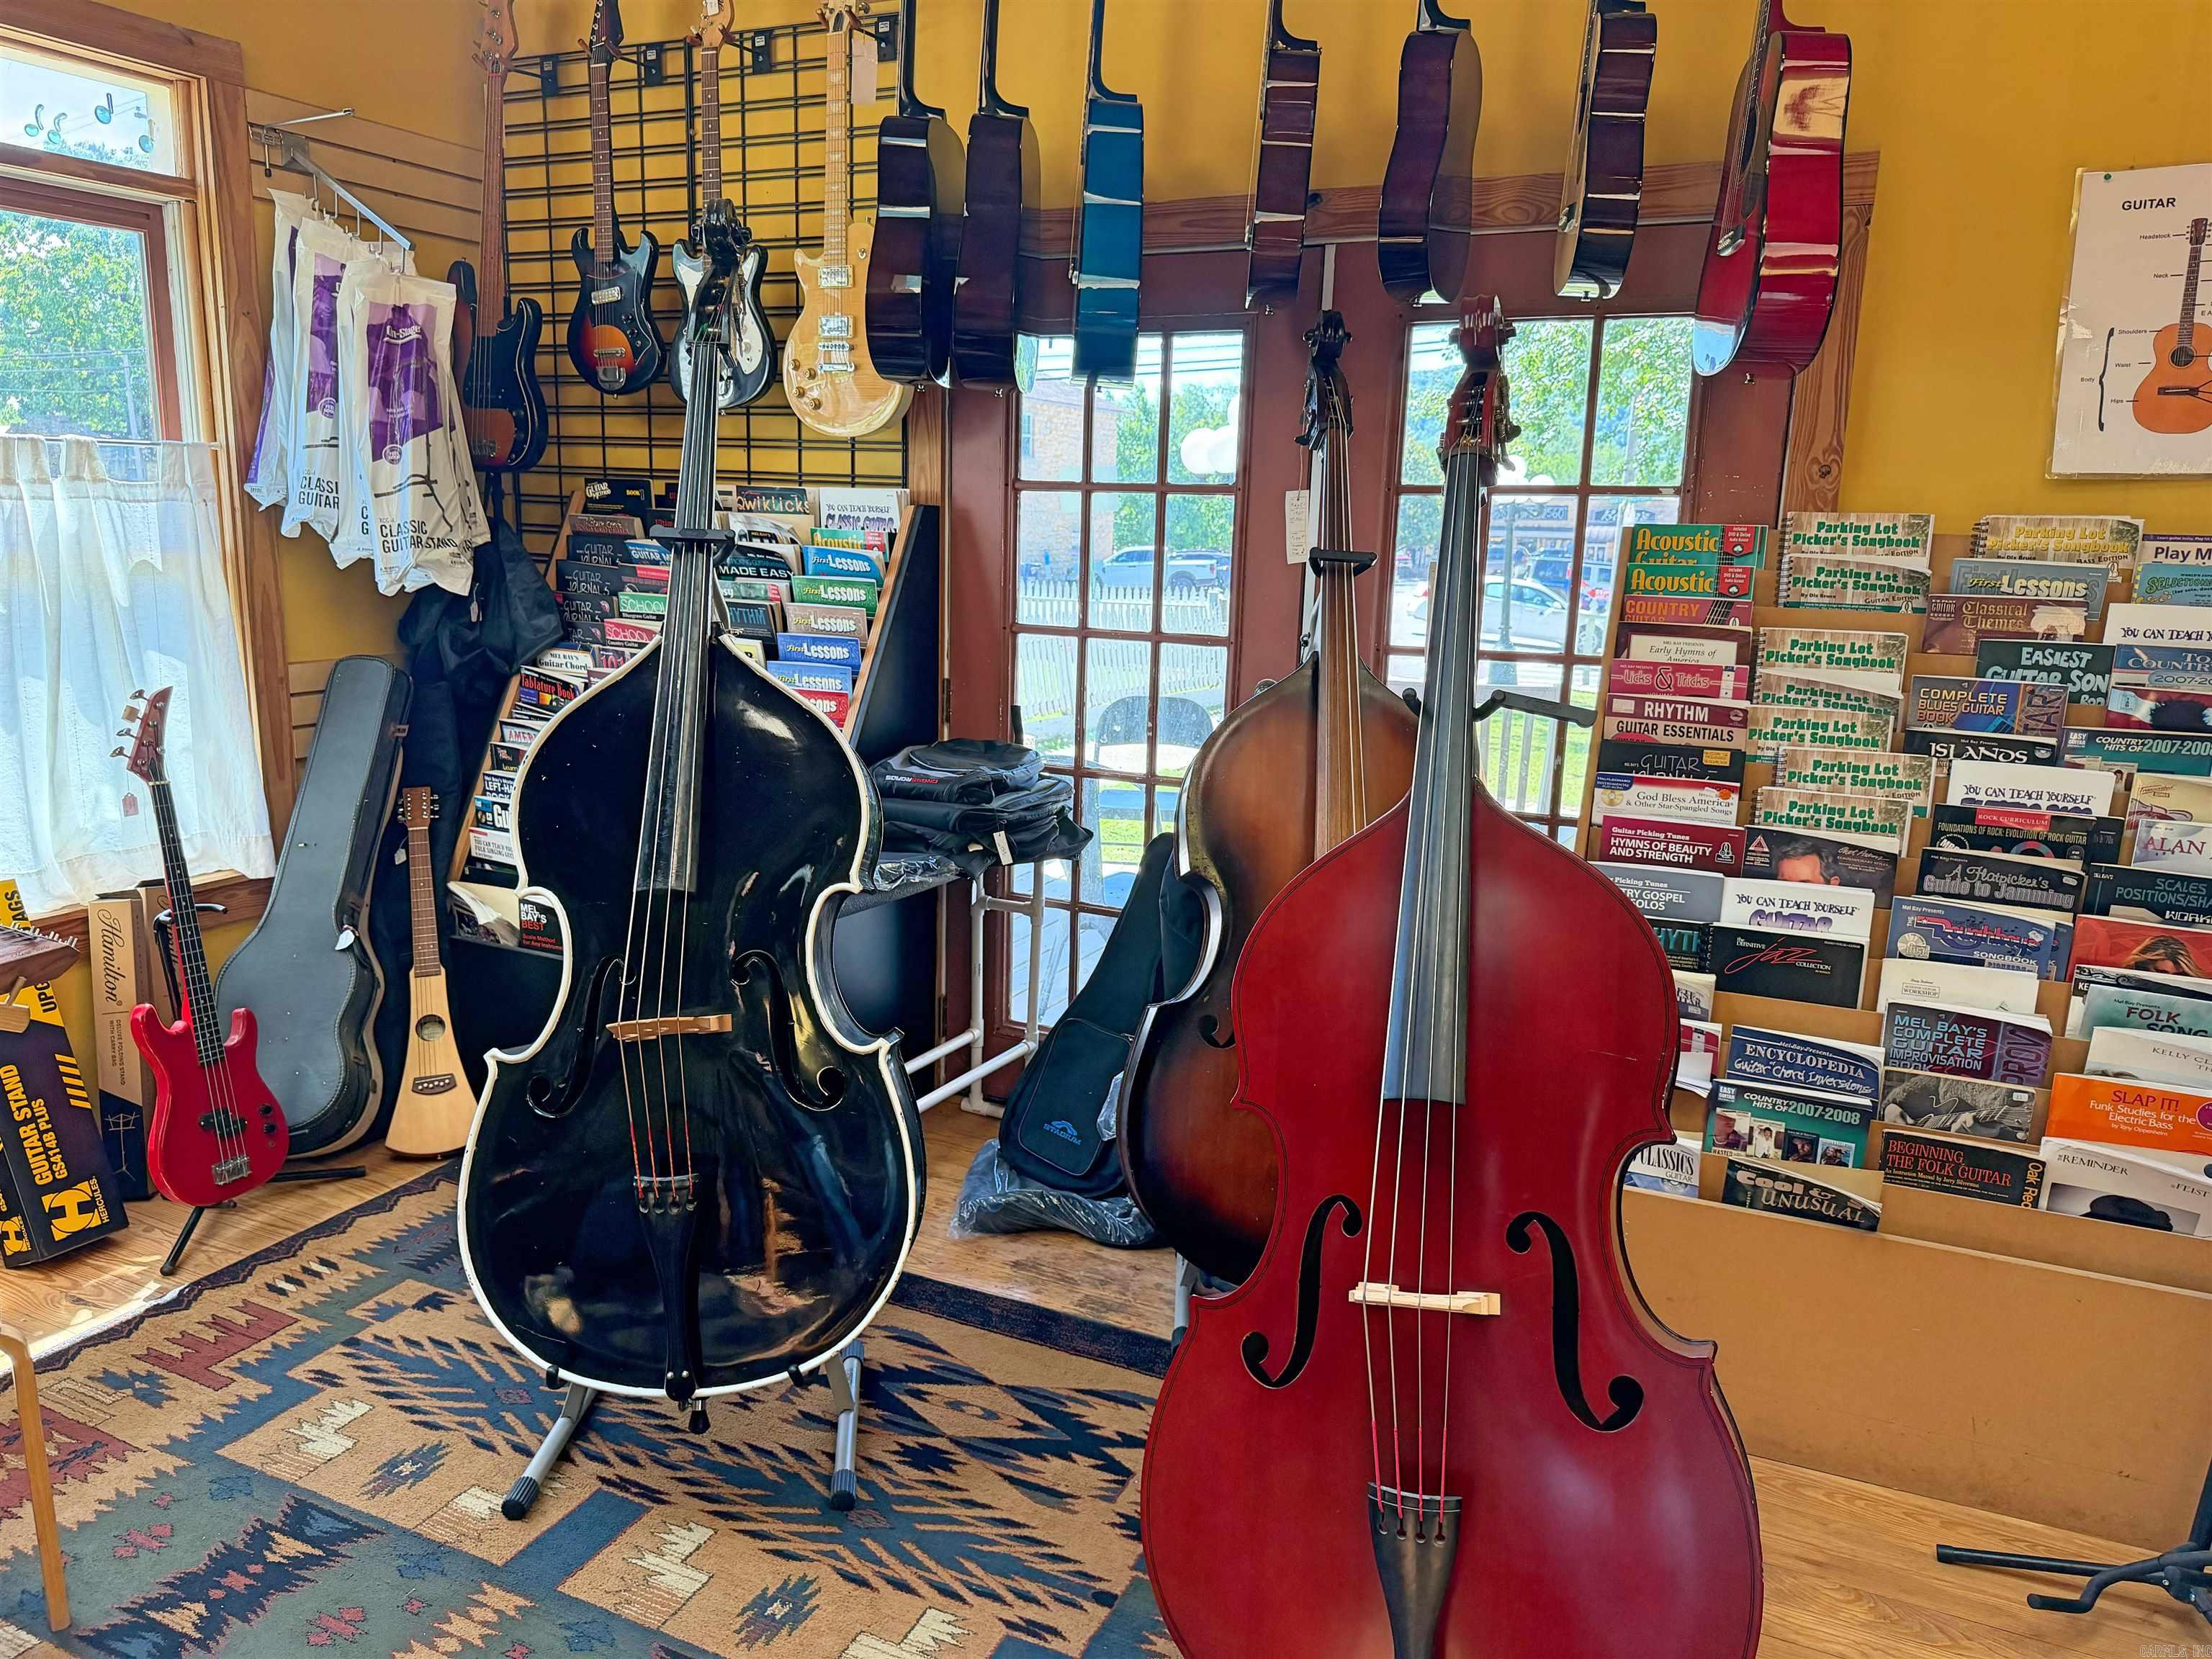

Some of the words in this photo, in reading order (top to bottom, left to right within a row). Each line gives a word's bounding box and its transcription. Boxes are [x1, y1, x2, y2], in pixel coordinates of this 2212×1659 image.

[2122, 198, 2176, 210] GUITAR
[387, 325, 421, 338] On-Stage
[849, 504, 866, 513] TEACH
[380, 520, 428, 538] CLASSIC
[1817, 521, 1871, 535] Parking
[1875, 523, 1898, 534] Lot
[2015, 526, 2076, 540] Parking
[2080, 527, 2106, 539] Lot
[382, 536, 423, 553] GUITAR
[424, 537, 457, 549] STAND
[585, 544, 613, 554] GUITAR
[1636, 528, 1719, 552] Acoustic
[1792, 534, 1848, 546] Picker's
[1852, 534, 1920, 549] Songbook
[631, 551, 660, 561] GUITAR
[812, 556, 830, 565] First
[830, 554, 871, 572] Lessons
[2154, 547, 2190, 562] Play
[719, 565, 757, 576] MADE
[761, 567, 794, 577] EASY
[1816, 567, 1871, 581] Parking
[1875, 571, 1898, 583] Lot
[1631, 568, 1714, 593] Acoustic
[1791, 577, 1848, 590] Picker's
[1852, 580, 1920, 595] Songbook
[820, 585, 866, 602] Lessons
[1626, 600, 1699, 616] COUNTRY
[811, 614, 856, 632] Lessons
[2121, 627, 2139, 637] YOU
[2143, 629, 2165, 639] CAN
[2168, 630, 2204, 641] TEACH
[804, 642, 850, 660] Lessons
[1650, 645, 1671, 655] Early
[1675, 647, 1705, 657] Hymns
[1790, 639, 1845, 655] Parking
[1849, 642, 1874, 655] Lot
[1766, 650, 1822, 665] Picker's
[1826, 654, 1895, 668] Songbook
[521, 673, 555, 695] Tablature
[557, 684, 575, 700] Book
[795, 673, 842, 691] Lessons
[1920, 688, 2008, 704] COMPLETE
[1644, 701, 1709, 722] RHYTHM
[1917, 711, 1956, 723] BOOK
[1918, 701, 1958, 713] BLUES
[1961, 703, 2005, 716] GUITAR
[1617, 721, 1659, 735] GUITAR
[1663, 724, 1734, 742] ESSENTIALS
[1773, 717, 1829, 732] Parking
[1833, 721, 1857, 733] Lot
[1748, 729, 1805, 742] Picker's
[1809, 732, 1881, 748] Songbook
[2095, 736, 2146, 745] COUNTRY
[1812, 760, 1870, 776] Parking
[1874, 763, 1899, 775] Lot
[1787, 770, 1846, 786] Picker's
[1850, 774, 1923, 791] Songbook
[1964, 784, 1981, 796] YOU
[1984, 787, 2008, 798] CAN
[2010, 788, 2044, 800] TEACH
[2046, 791, 2093, 804] YOURSELF
[1658, 803, 1709, 813] Star-Spangled
[1711, 806, 1732, 816] Songs
[1788, 800, 1845, 818] Parking
[1850, 806, 1874, 819] Lot
[1763, 811, 1822, 827] Picker's
[1825, 817, 1898, 835] Songbook
[2000, 817, 2049, 825] CURRICULUM
[1611, 827, 1635, 835] Guitar
[1636, 829, 1665, 840] Picking
[1667, 832, 1689, 841] Tunes
[1609, 847, 1634, 857] AND
[1635, 848, 1693, 863] STRENGTH
[1611, 837, 1650, 849] HYMNS
[1652, 842, 1666, 850] OF
[1668, 843, 1712, 856] BEAUTY
[1615, 877, 1644, 886] Picking
[1642, 891, 1686, 904] GOSPEL
[1735, 894, 1753, 904] YOU
[1756, 897, 1776, 908] CAN
[1779, 899, 1811, 910] TEACH
[1813, 902, 1857, 916] YOURSELF
[521, 903, 539, 914] MEL
[521, 912, 547, 923] BAY'S
[521, 920, 545, 930] BEST
[97, 908, 126, 1002] Hamilton
[1973, 950, 2038, 966] SONGBOOK
[1796, 962, 1831, 971] COLLECTION
[1894, 1015, 1930, 1029] MEL
[1937, 1021, 1987, 1038] BAY'S
[1893, 1027, 1985, 1049] COMPLETE
[1892, 1038, 1983, 1059] GUITAR
[1744, 1043, 1866, 1079] ENCYCLOPEDIA
[1889, 1048, 1982, 1071] IMPROVISATION
[0, 1064, 33, 1122] STAND
[1719, 1086, 1735, 1094] EASY
[1744, 1092, 1789, 1106] COUNTRY
[1752, 1101, 1773, 1110] HITS
[2111, 1090, 2156, 1107] SLAP
[2161, 1097, 2179, 1112] IT!
[31, 1097, 53, 1131] PLUS
[1787, 1102, 1861, 1125] 2007-2008
[2089, 1100, 2114, 1112] Funk
[2117, 1105, 2157, 1119] Studies
[2160, 1108, 2175, 1121] for
[2178, 1115, 2196, 1125] the
[2108, 1112, 2148, 1126] Electric
[2148, 1118, 2173, 1130] Bass
[19, 1123, 54, 1187] GUITAR
[43, 1132, 68, 1179] GS414B
[1889, 1140, 1964, 1164] BEGINNING
[1887, 1154, 1914, 1169] THE
[1917, 1159, 1954, 1176] FOLK
[1958, 1164, 2011, 1187] GUITAR
[2026, 1162, 2043, 1185] Oak
[2063, 1154, 2129, 1176] REMINDER
[89, 1178, 109, 1223] HERCULES
